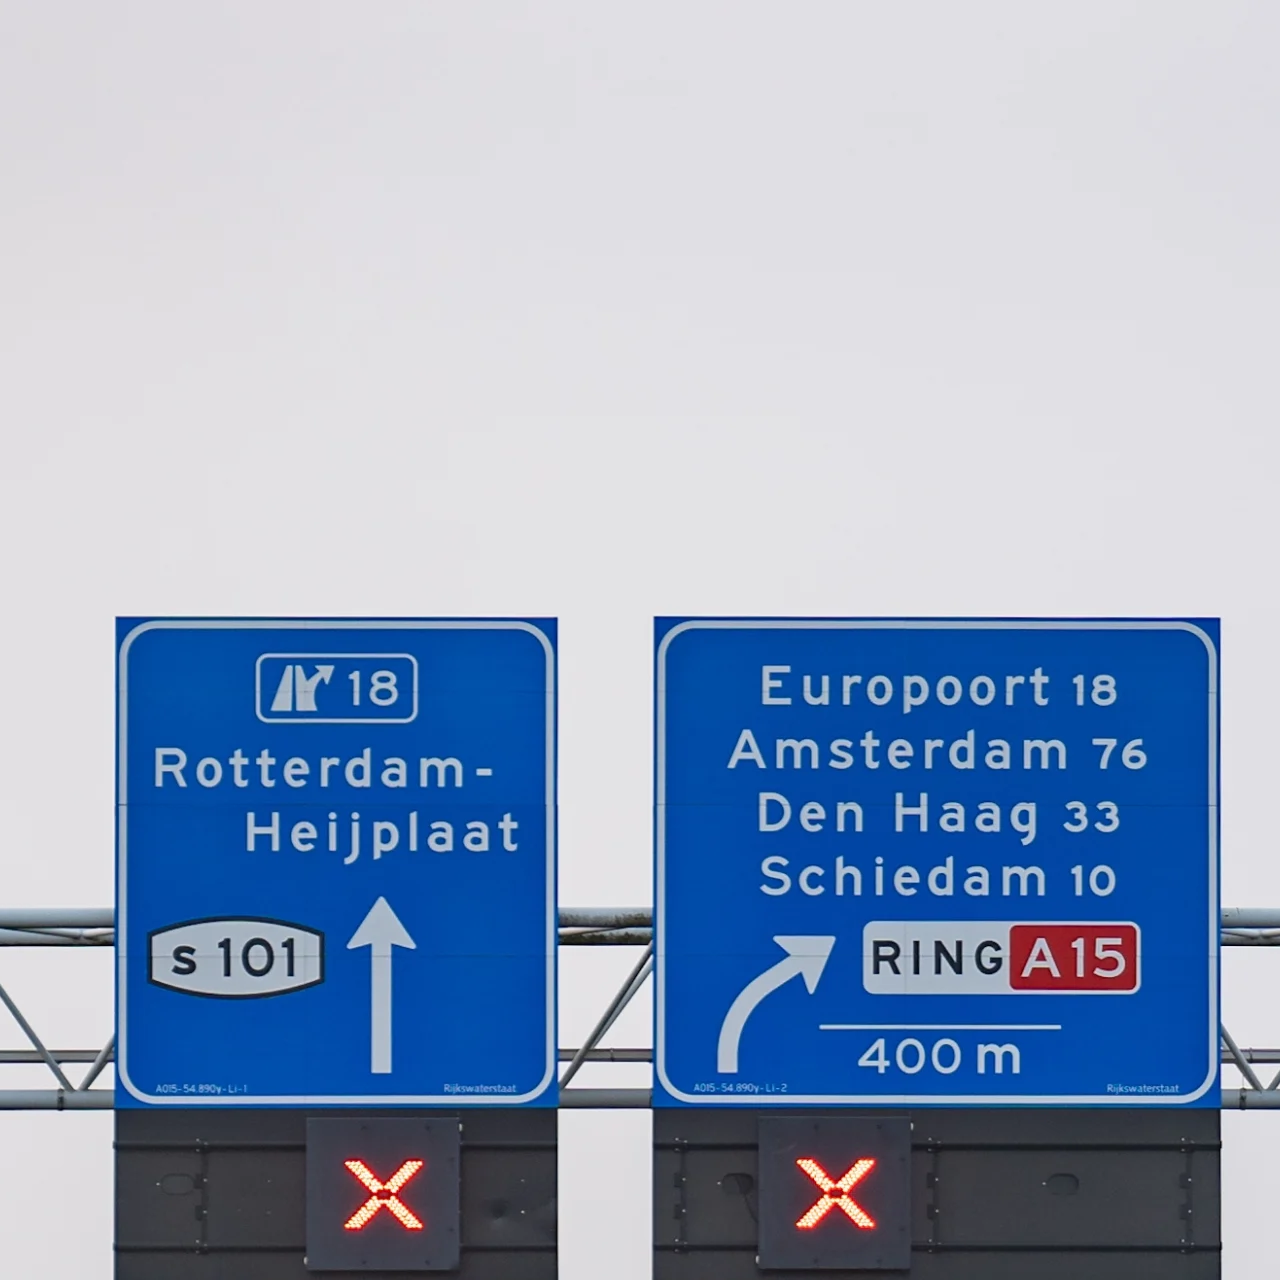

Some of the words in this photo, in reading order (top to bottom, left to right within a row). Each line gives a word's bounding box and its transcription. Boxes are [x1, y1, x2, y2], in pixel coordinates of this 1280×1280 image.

[348, 670, 399, 706] 18
[761, 665, 1049, 714] Europoort
[1072, 674, 1117, 706] 18
[154, 747, 493, 788] Rotterdam-
[727, 729, 1066, 769] Amsterdam
[1092, 738, 1147, 770] 76
[246, 811, 519, 865] Heijplaat
[759, 792, 863, 832] Den
[895, 792, 1037, 845] Haag
[1063, 801, 1120, 833] 33
[760, 855, 1045, 897] Schiedam
[1071, 864, 1117, 897] 10
[172, 946, 197, 976] s
[218, 937, 295, 978] 101
[871, 939, 1004, 975] RING
[1020, 937, 1126, 978] A15
[858, 1038, 962, 1074] 400
[977, 1042, 1021, 1073] m
[443, 1083, 517, 1094] Rijkswaterstaat
[1106, 1083, 1180, 1095] Rijkswaterstaat
